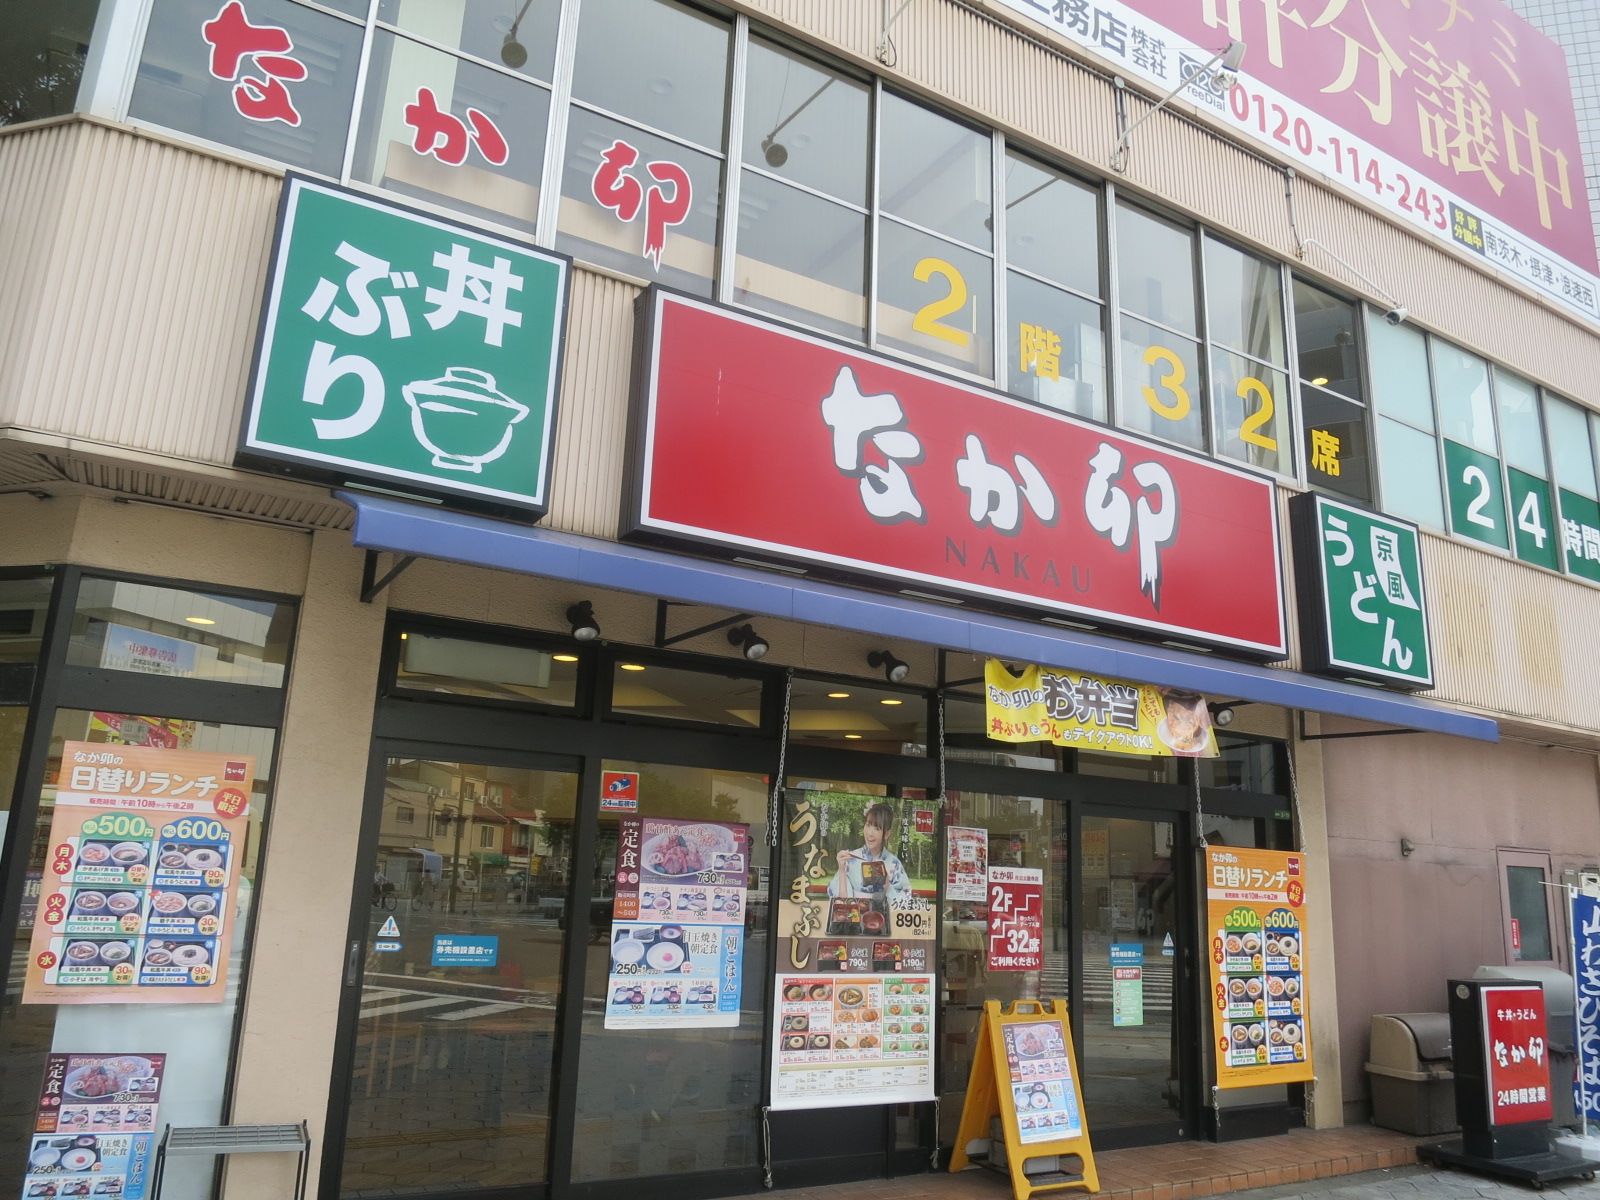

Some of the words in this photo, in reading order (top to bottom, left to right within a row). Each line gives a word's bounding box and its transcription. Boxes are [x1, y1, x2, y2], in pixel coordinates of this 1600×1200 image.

[1019, 0, 1127, 58] 務店
[1131, 25, 1166, 60] 株式
[1132, 47, 1167, 80] 会社
[202, 0, 692, 272] なか卯
[1229, 82, 1447, 230] 0120-114-243
[821, 365, 1178, 608] なか卯
[945, 536, 1093, 593] NAKAU
[1375, 535, 1405, 600] 京風
[1324, 514, 1413, 671] うどん
[988, 685, 1044, 709] なか卯の
[1042, 673, 1139, 731] お弁当
[73, 751, 125, 764] なか卯の
[71, 765, 219, 797] 日替りランチ
[217, 801, 238, 815] 限定
[224, 793, 241, 805] 平日
[98, 816, 154, 837] 500円
[177, 820, 230, 841] 600円
[620, 829, 639, 869] 定食
[789, 801, 829, 969] うなまぶし
[992, 870, 1014, 881] なか卯
[1213, 865, 1288, 889] 日替りランチ
[991, 885, 1013, 912] 2F
[896, 913, 928, 929] 890円
[681, 929, 718, 943] 目玉焼き
[690, 943, 718, 955] 朝定食
[1007, 929, 1040, 954] 32席
[40, 955, 53, 967] 水
[723, 936, 738, 993] 朝ごはん
[991, 956, 1040, 967] ご利用ください
[1497, 1008, 1537, 1021] 牛丼・うどん
[1494, 1036, 1544, 1068] なか卯
[47, 1063, 64, 1094] 定食
[1497, 1086, 1547, 1107] 24時間営業
[130, 1141, 148, 1184] 朝ごはん
